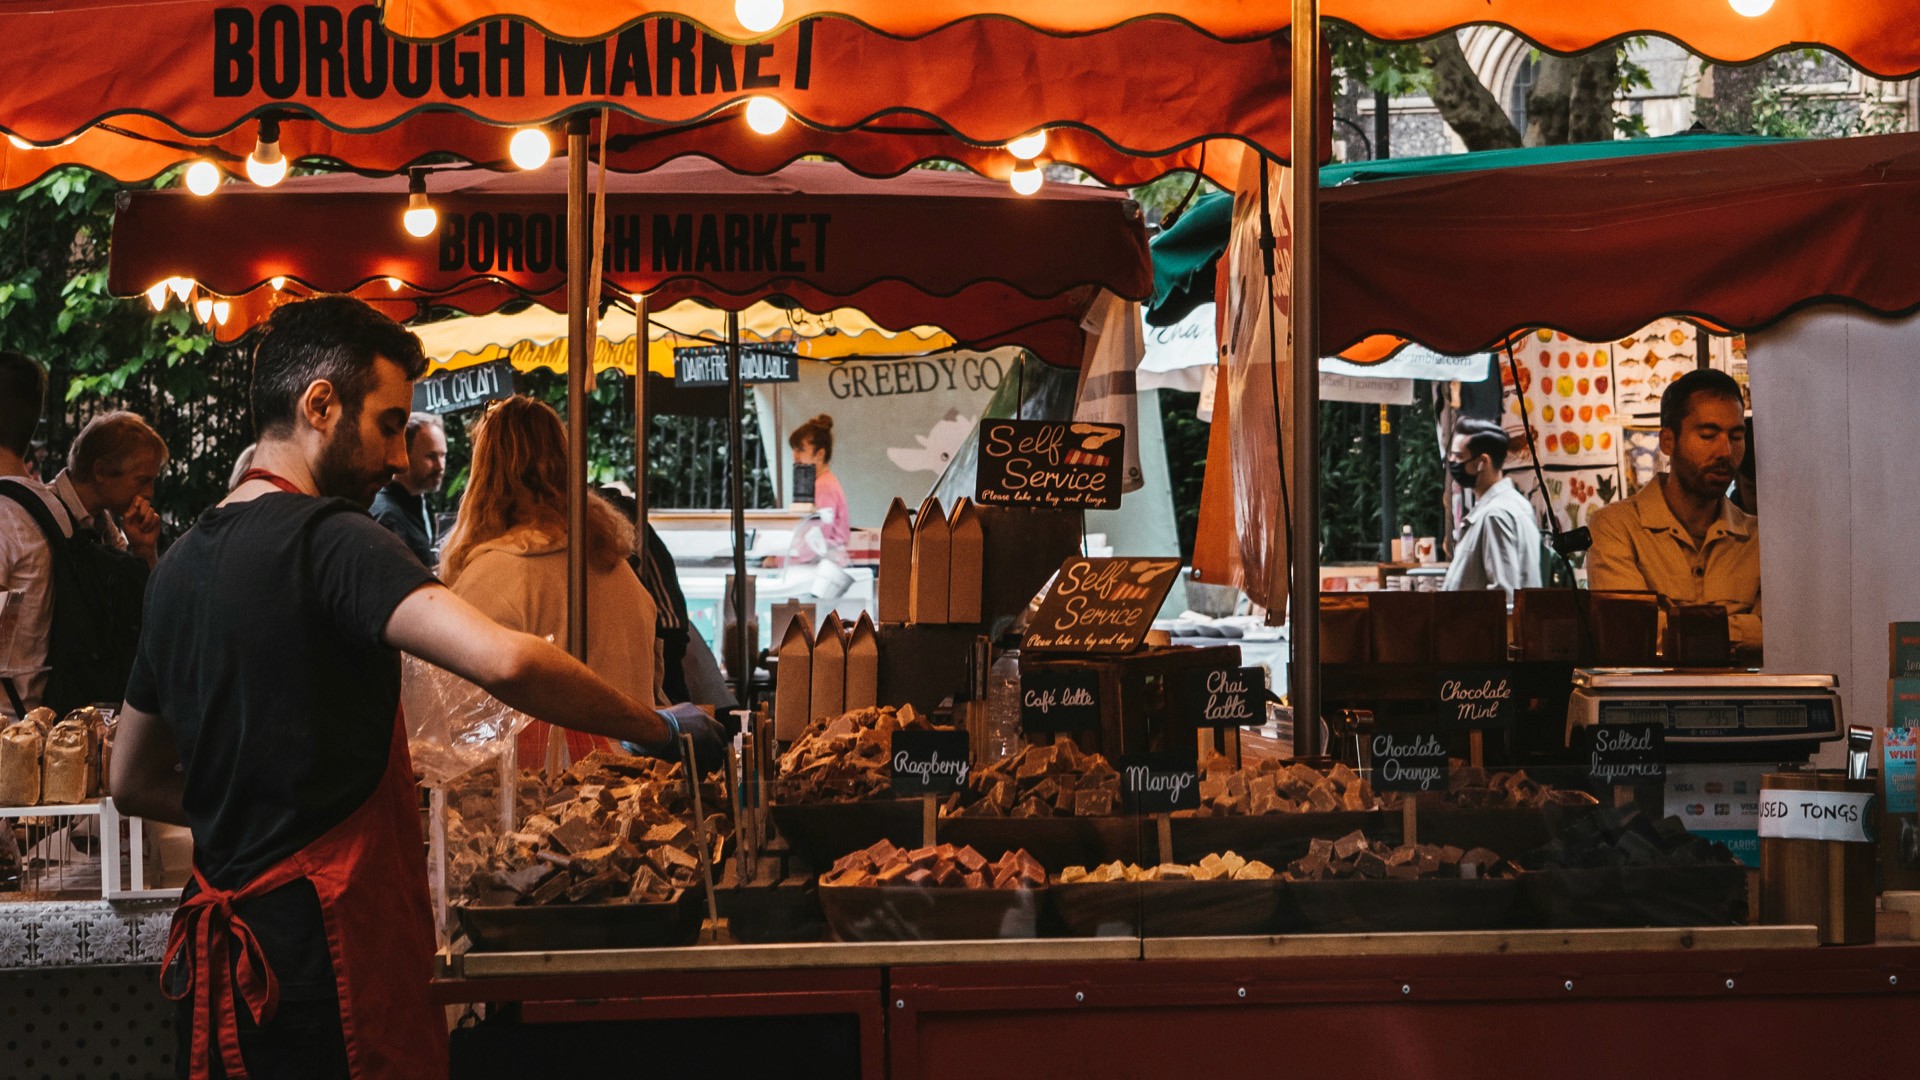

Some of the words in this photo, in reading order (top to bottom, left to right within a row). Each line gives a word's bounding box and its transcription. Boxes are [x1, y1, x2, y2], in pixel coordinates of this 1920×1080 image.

[214, 4, 524, 99] BOROUGH
[545, 17, 823, 96] MARKET
[651, 213, 832, 273] MARKET
[682, 354, 729, 382] DAIRY-FRE
[828, 357, 958, 399] GREEDY
[423, 376, 450, 411] ICE
[452, 365, 499, 403] CREAM
[986, 424, 1066, 466] Self
[1001, 457, 1107, 491] Service
[981, 489, 1010, 501] Please
[1045, 492, 1059, 507] bag
[1064, 493, 1082, 503] and
[1057, 560, 1128, 600] Self
[1054, 595, 1143, 631] Service
[1026, 633, 1052, 648] Please
[1098, 633, 1118, 645] and
[1206, 670, 1248, 694] Chai
[1440, 679, 1511, 701] Chocolate
[1024, 687, 1057, 713] Café
[1060, 687, 1094, 707] latte
[1203, 695, 1253, 720] latte
[1457, 700, 1499, 720] Mint
[1372, 734, 1446, 757] Chocolate
[1595, 727, 1653, 752] Salted
[894, 750, 969, 785] Raspberry
[1383, 758, 1441, 790] Orange
[1589, 752, 1662, 784] liquorice
[1126, 766, 1194, 804] Mango
[1674, 784, 1694, 792] VISA
[1760, 801, 1789, 818] USED
[1800, 802, 1858, 823] TONGS
[1727, 840, 1757, 850] CARDS
